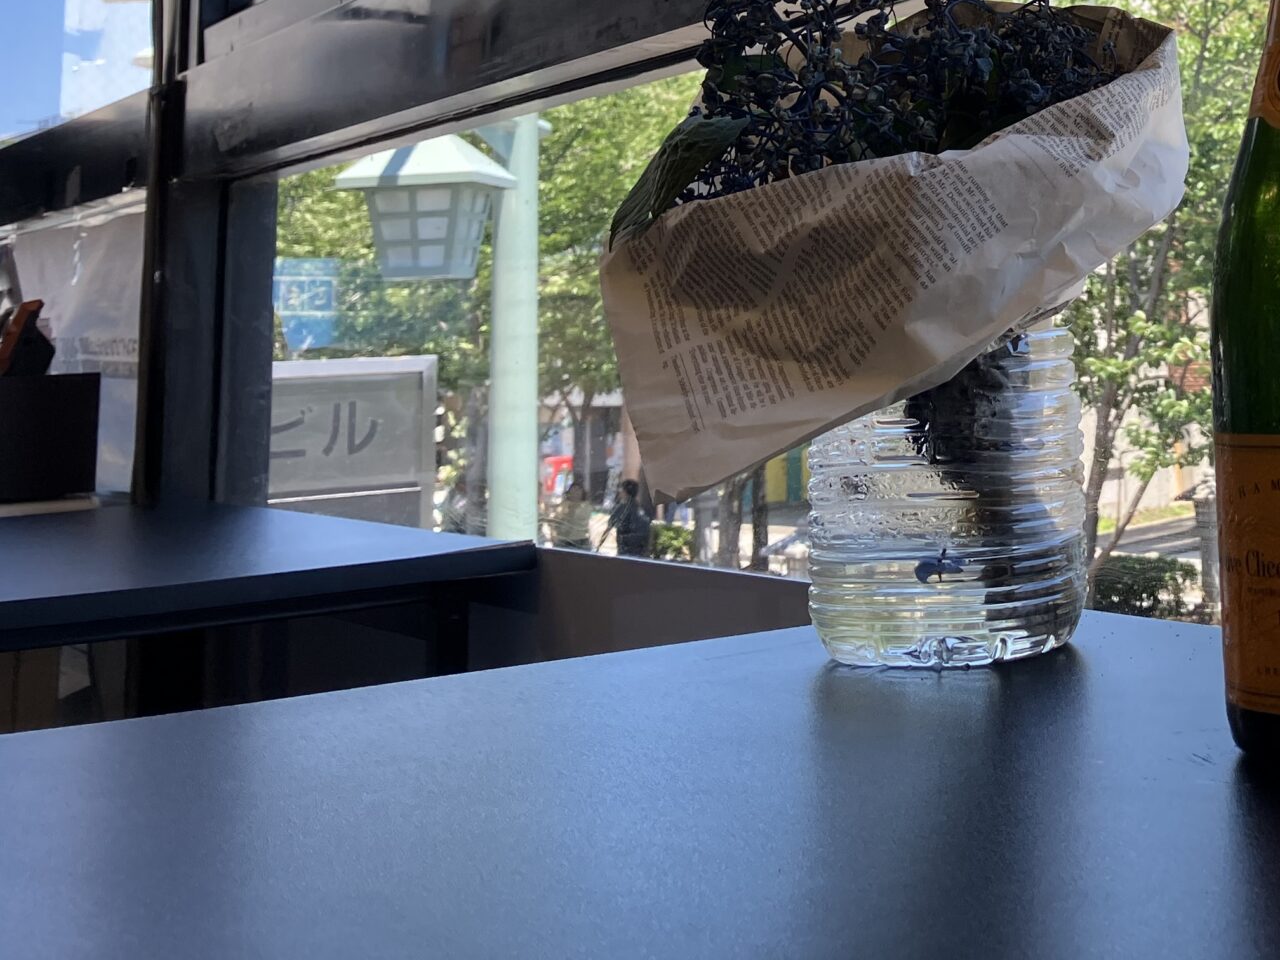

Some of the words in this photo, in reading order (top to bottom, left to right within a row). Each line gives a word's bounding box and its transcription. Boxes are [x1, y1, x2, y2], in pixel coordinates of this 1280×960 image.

[924, 178, 942, 198] 2024
[936, 195, 971, 238] presidential
[935, 177, 949, 193] Mr.
[945, 190, 973, 223] DeSantis
[968, 221, 979, 232] to
[946, 220, 957, 231] of
[948, 180, 965, 199] Fine
[960, 195, 988, 229] switched
[982, 225, 996, 240] his
[953, 170, 968, 187] and
[985, 213, 1004, 235] have
[965, 173, 991, 204] running
[987, 201, 998, 213] in
[994, 210, 1010, 229] that
